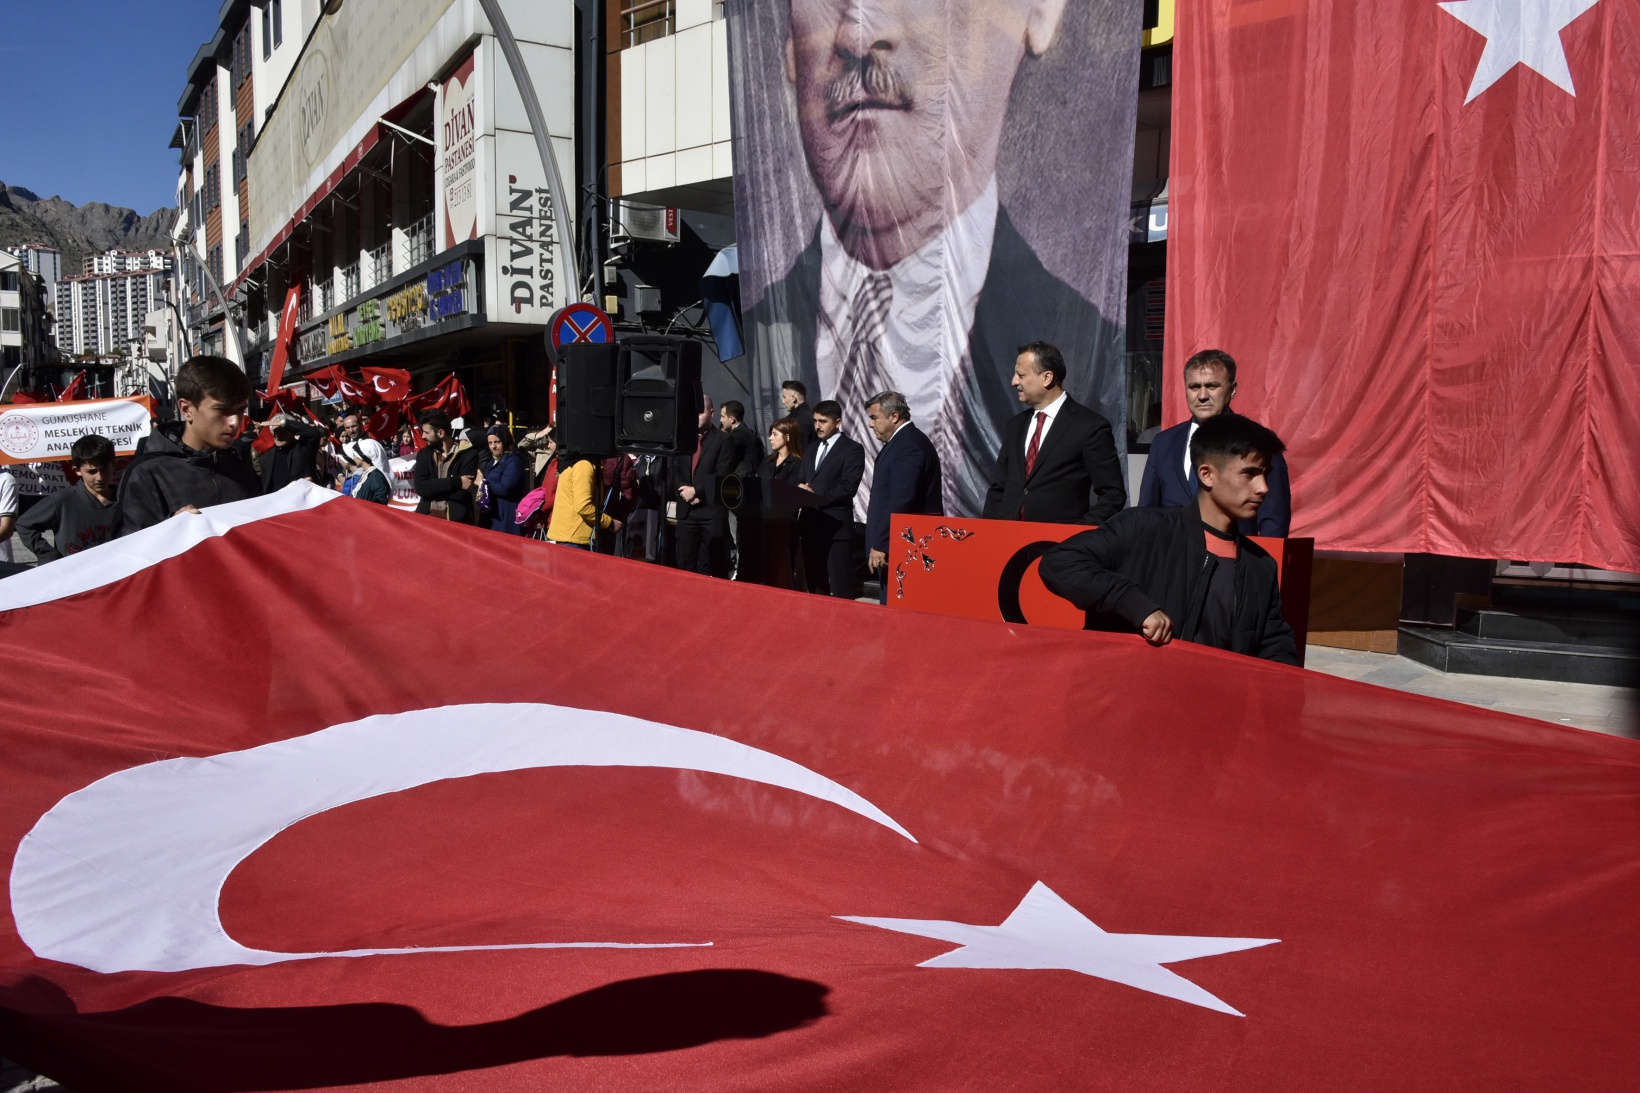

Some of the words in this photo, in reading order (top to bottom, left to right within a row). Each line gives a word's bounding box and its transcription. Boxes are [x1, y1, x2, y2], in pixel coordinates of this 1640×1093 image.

[444, 100, 475, 153] DİVAN
[445, 133, 475, 174] PASTANESİ
[502, 185, 534, 308] DİVAN
[535, 187, 554, 309] PASTANESİ
[42, 412, 108, 425] GÜMÜŞHANE
[44, 426, 89, 439] MESLEKİ
[90, 426, 104, 436] VE
[106, 423, 143, 433] TEKNİK
